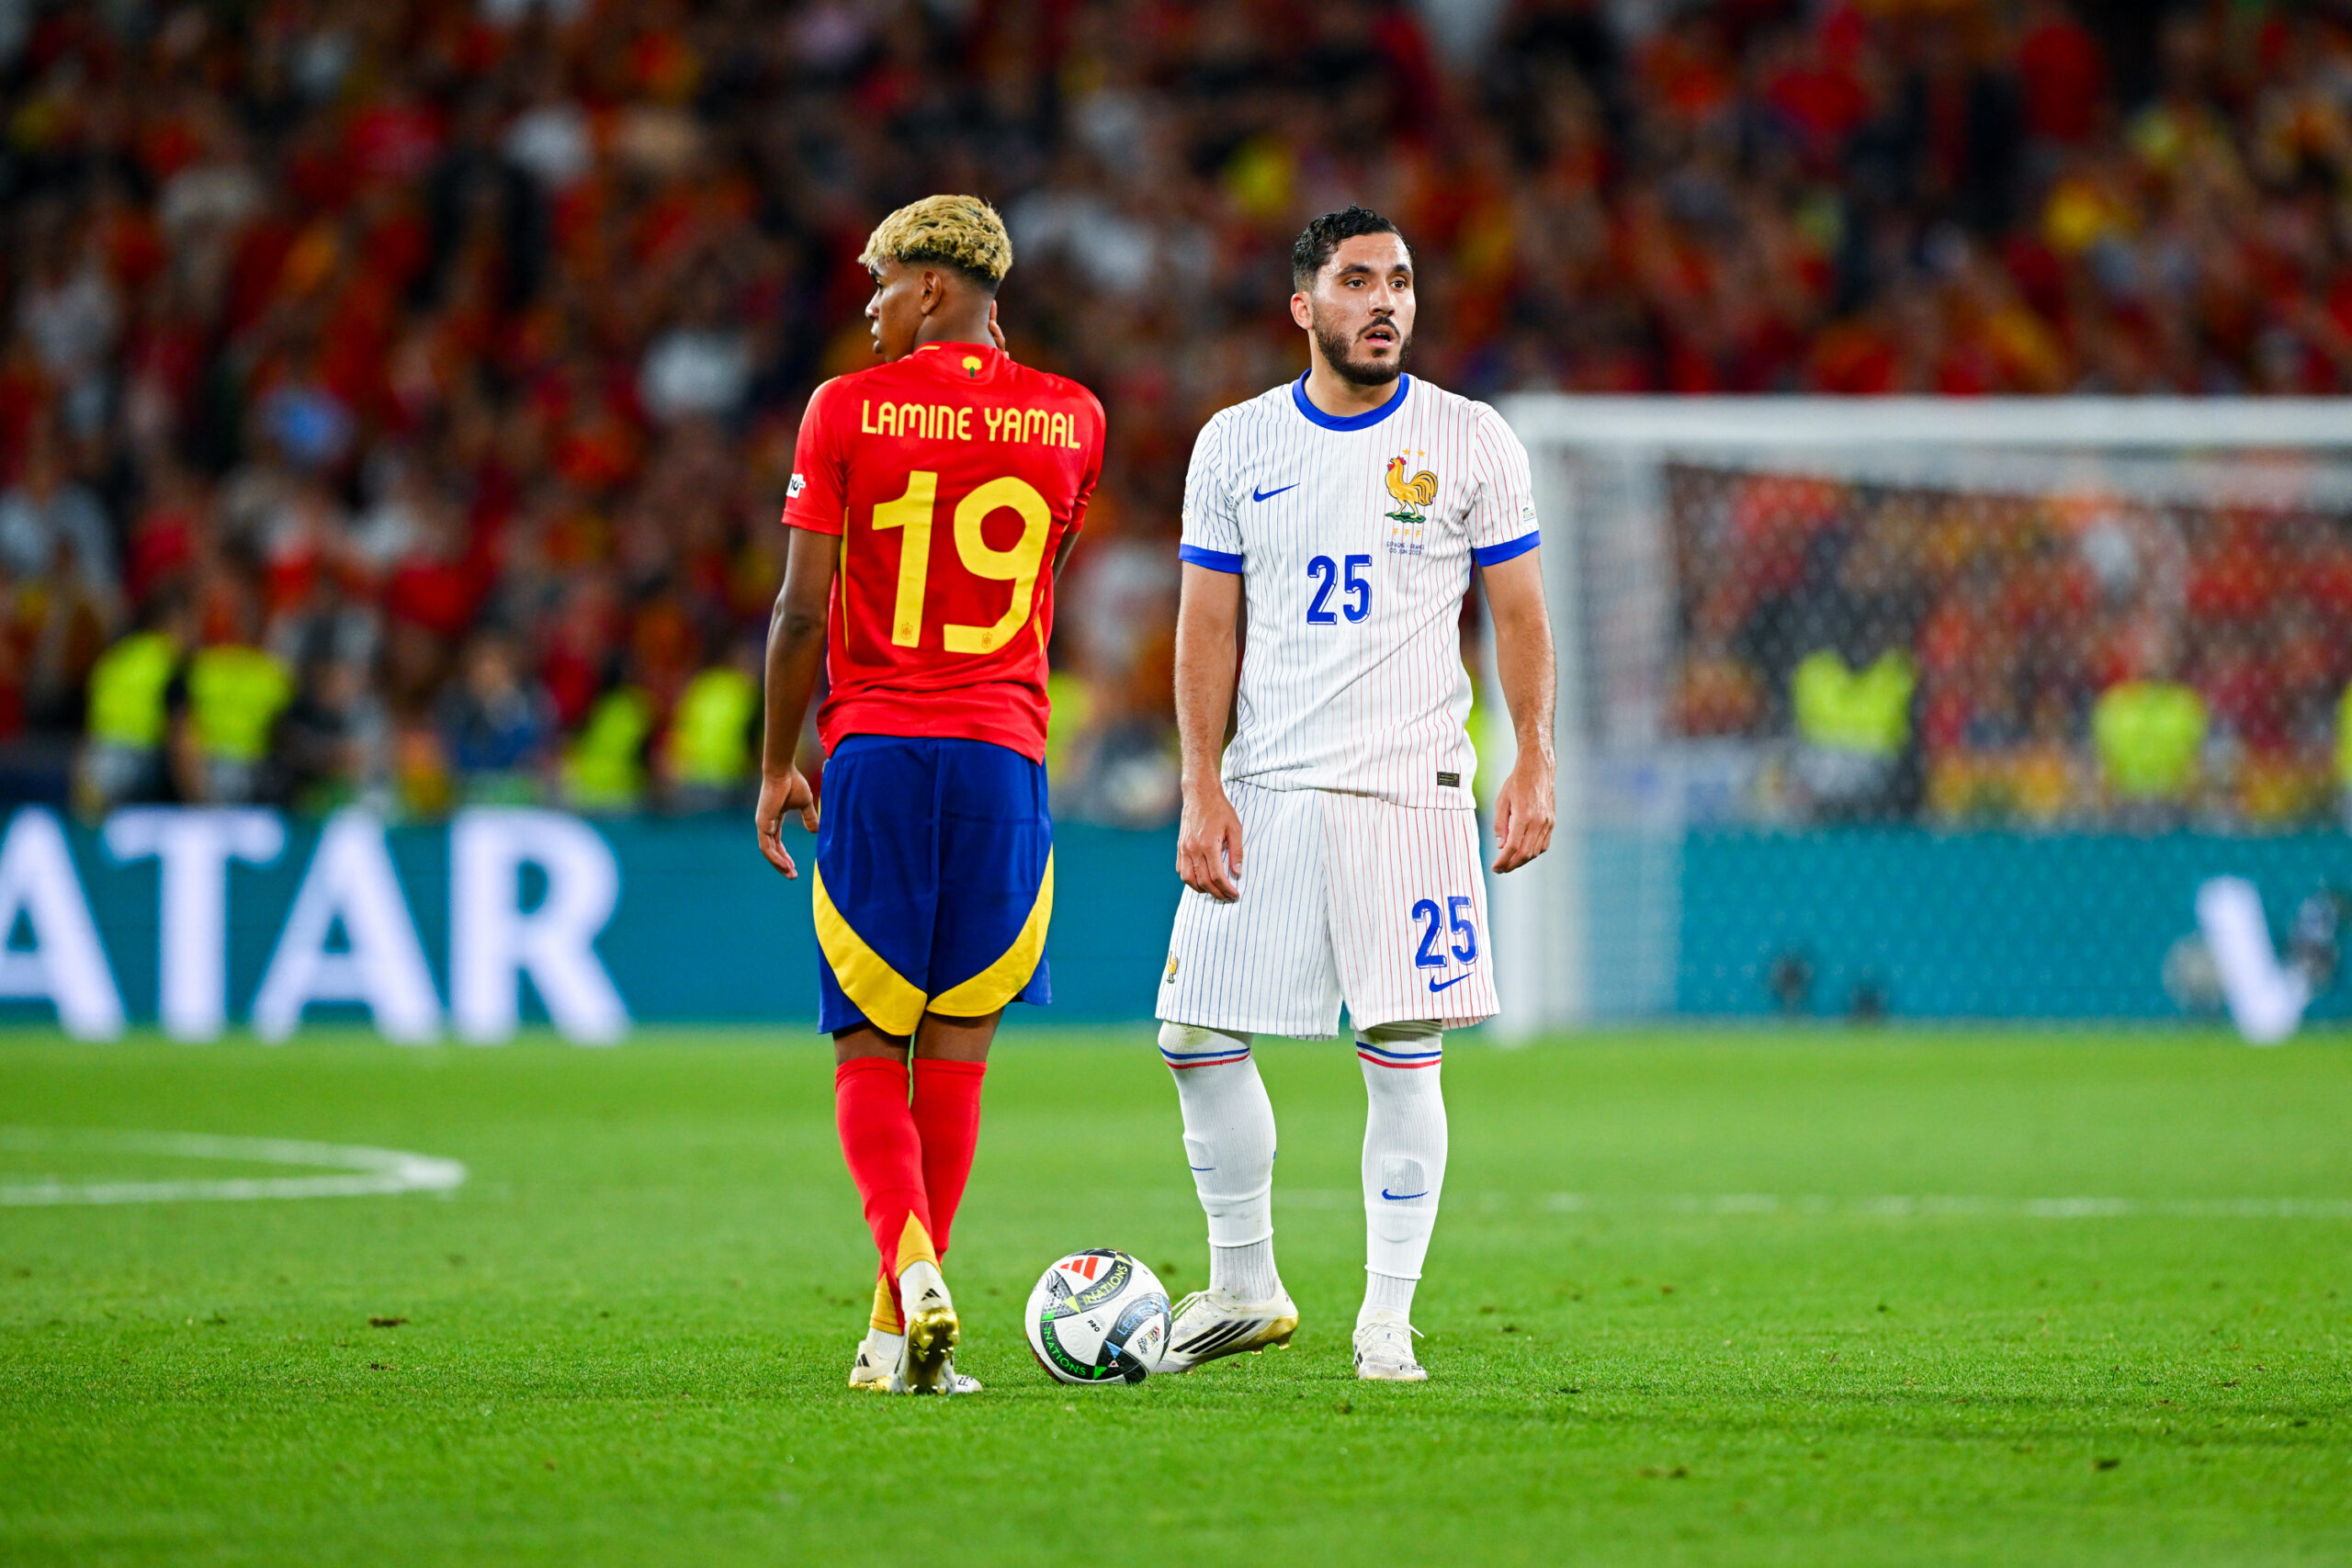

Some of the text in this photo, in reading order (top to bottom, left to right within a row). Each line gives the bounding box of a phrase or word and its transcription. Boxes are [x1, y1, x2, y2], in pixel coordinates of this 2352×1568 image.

[861, 400, 1081, 449] LAMINE YAMAL
[872, 469, 1052, 655] 19
[1306, 554, 1373, 626] 25
[1411, 896, 1479, 970] 25
[1087, 1320, 1101, 1334] PRO
